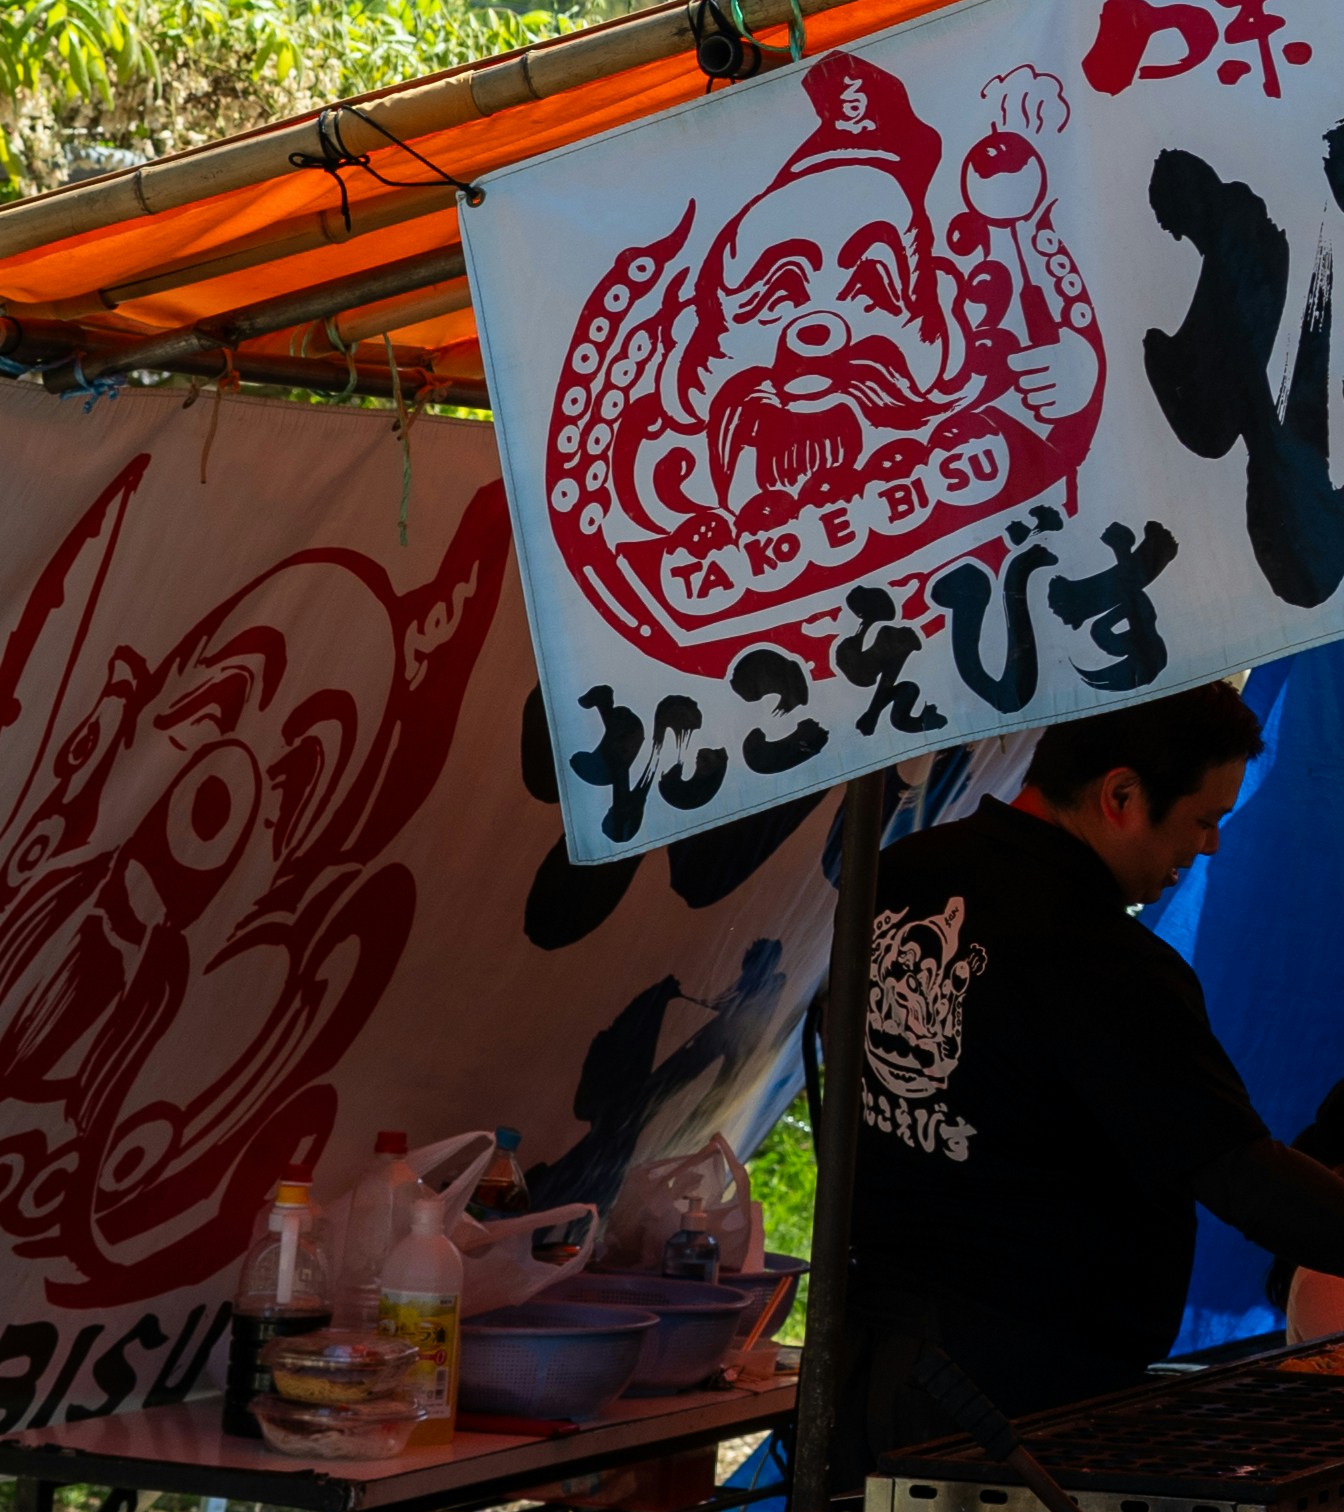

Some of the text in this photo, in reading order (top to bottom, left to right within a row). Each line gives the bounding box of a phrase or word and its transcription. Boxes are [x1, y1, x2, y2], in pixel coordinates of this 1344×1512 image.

[568, 500, 1183, 845] たこえびす
